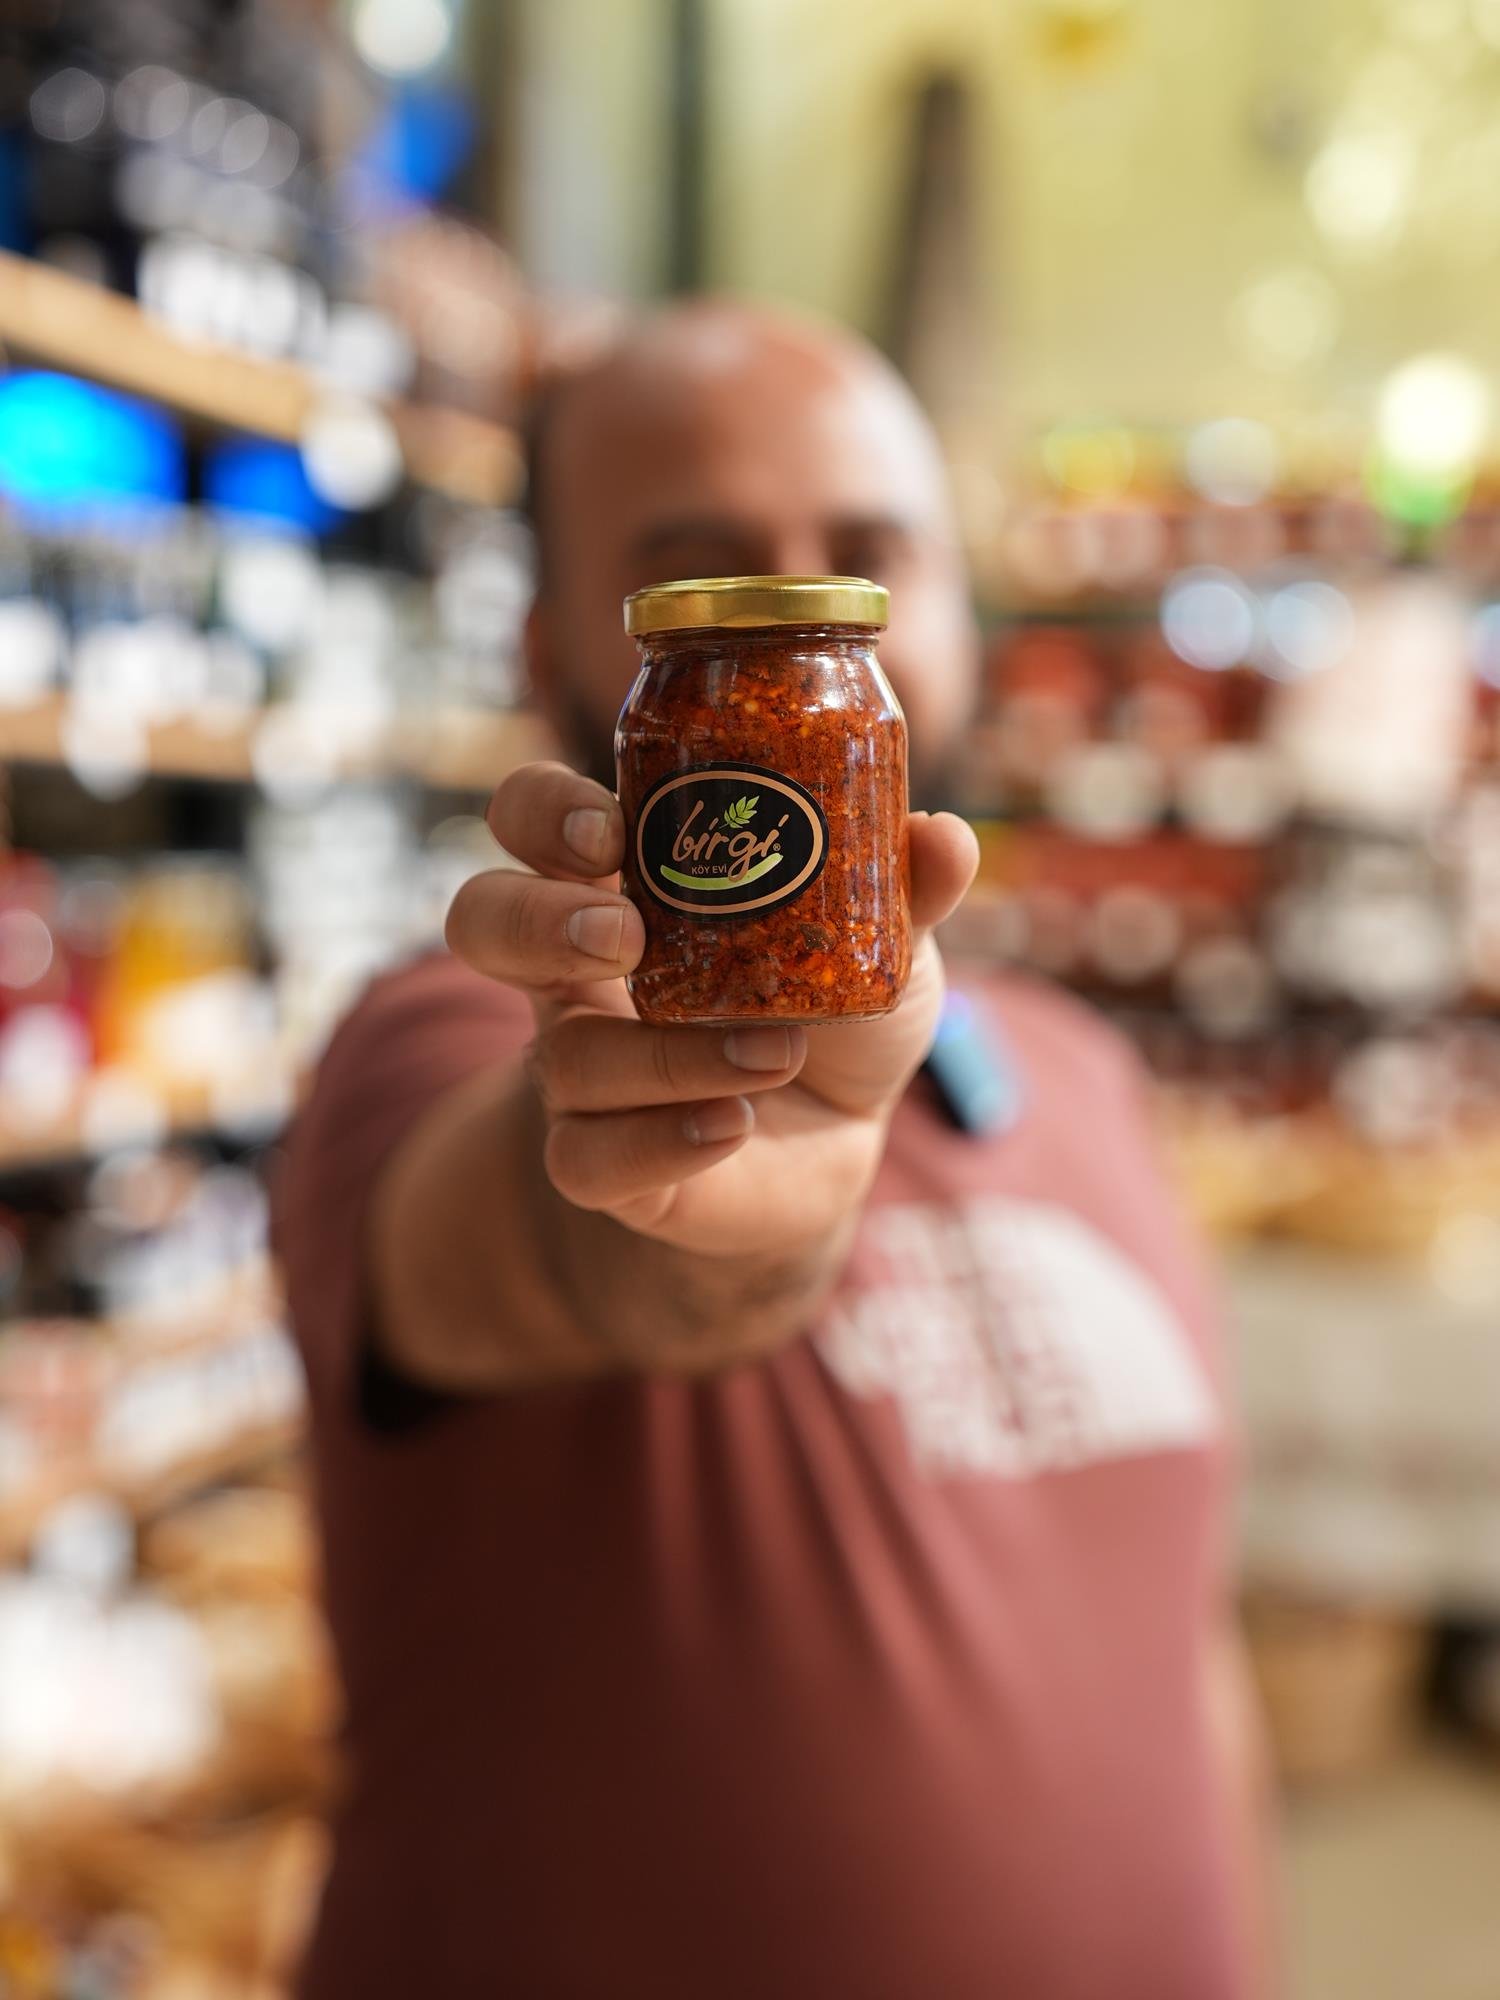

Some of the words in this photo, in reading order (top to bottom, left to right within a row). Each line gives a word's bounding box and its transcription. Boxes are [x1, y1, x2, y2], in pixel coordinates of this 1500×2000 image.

[672, 800, 789, 882] birgi
[691, 864, 710, 875] KÖY
[712, 864, 727, 874] EVİ
